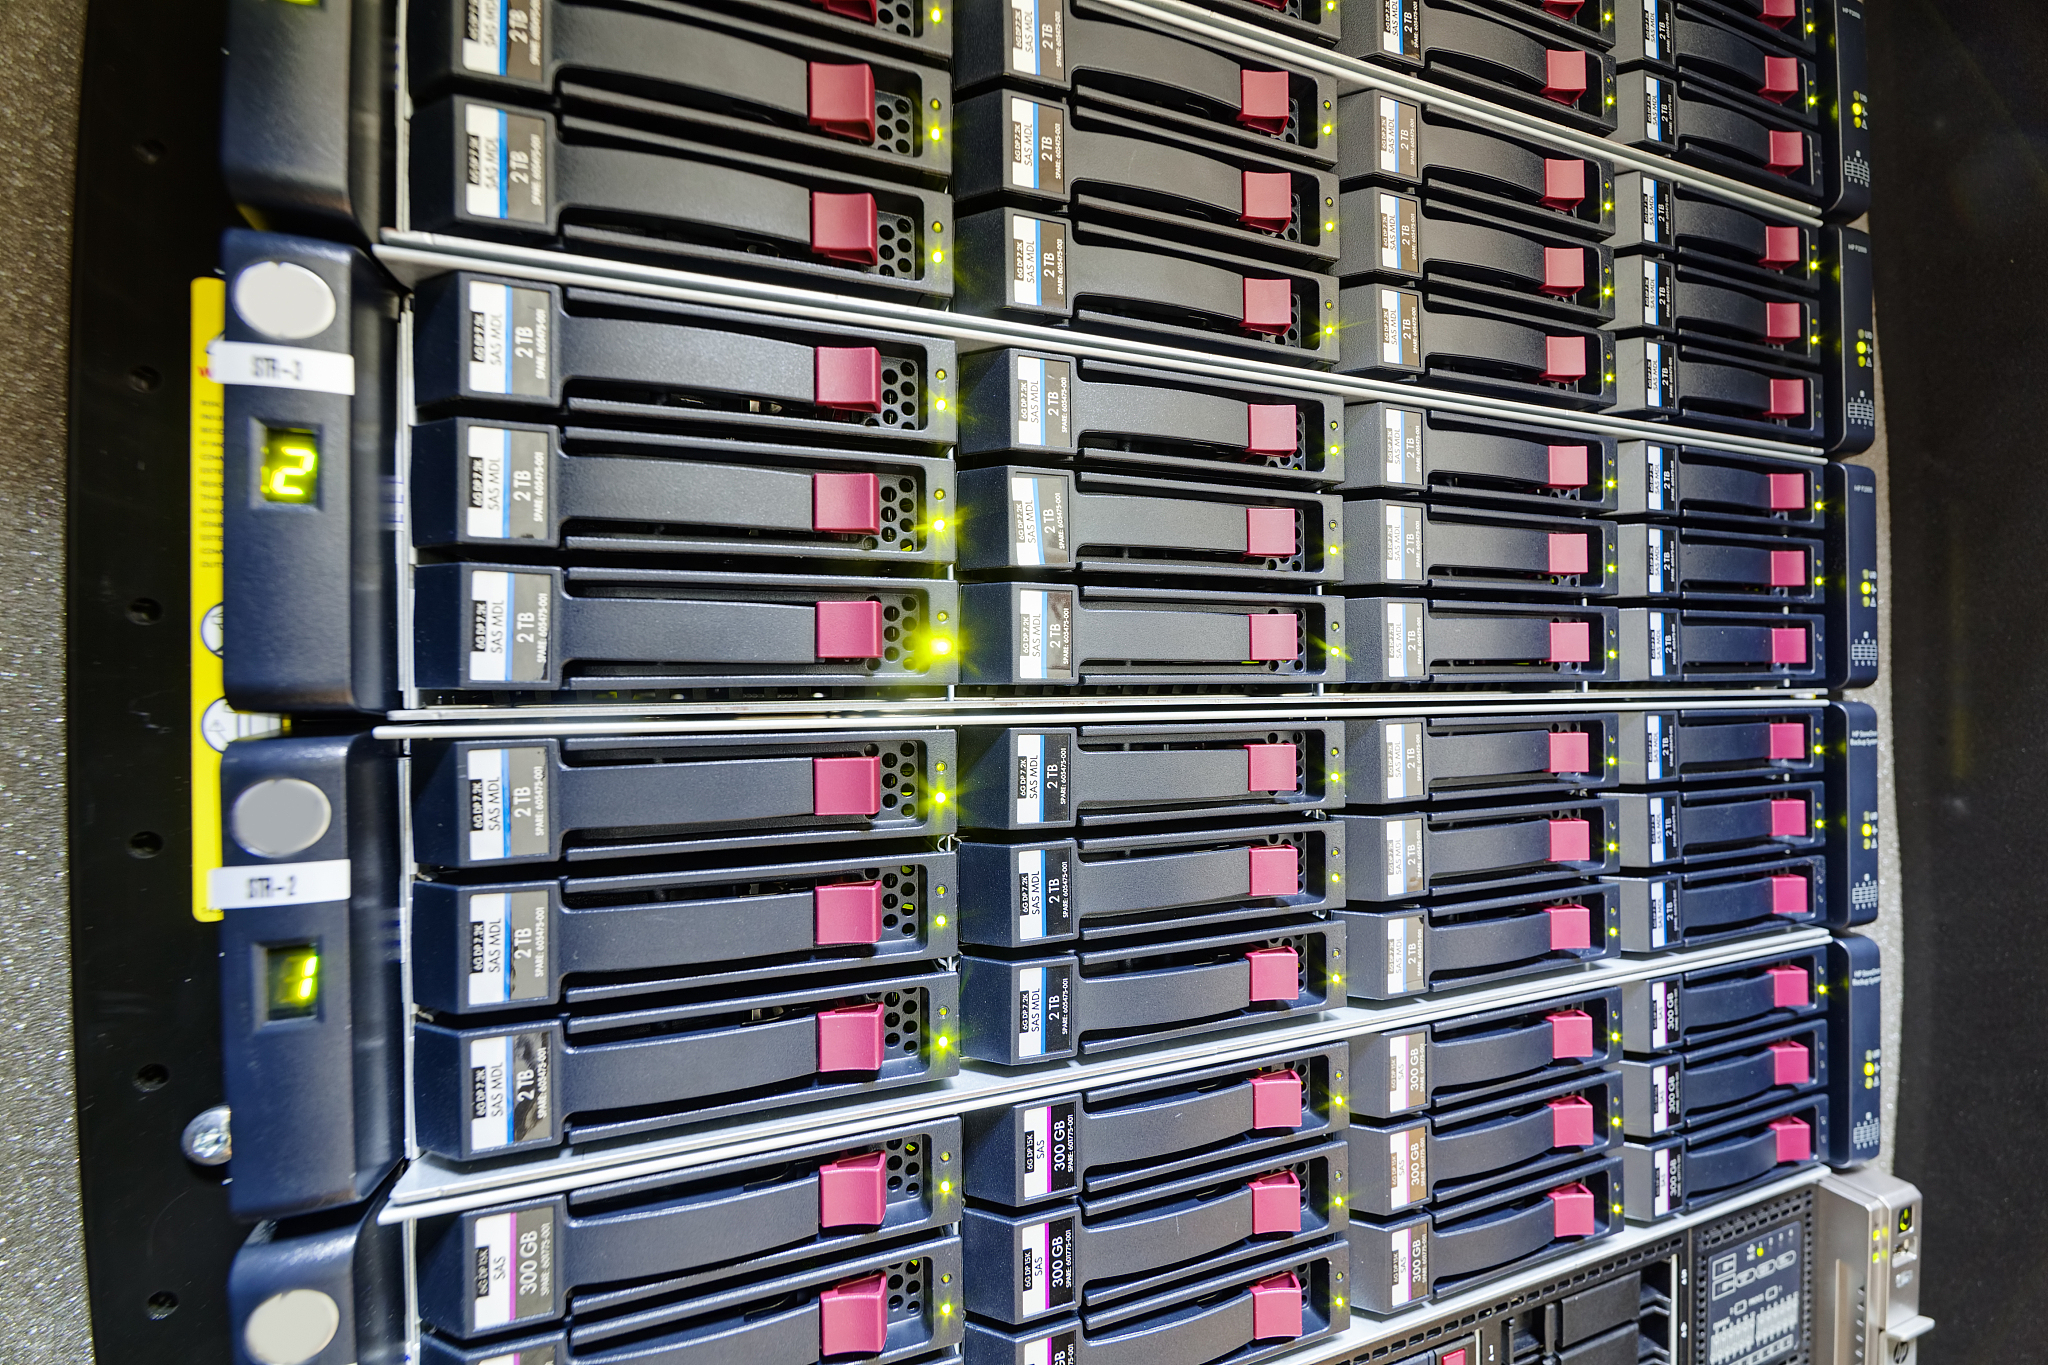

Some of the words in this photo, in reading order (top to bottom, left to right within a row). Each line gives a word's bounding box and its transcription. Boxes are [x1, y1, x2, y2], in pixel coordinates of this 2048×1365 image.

[1024, 9, 1033, 33] MDL
[1404, 11, 1412, 25] TB
[1041, 23, 1053, 40] TB
[1404, 25, 1412, 34] 2
[1025, 34, 1033, 54] SAS
[1042, 40, 1053, 50] 2
[1023, 122, 1032, 146] MDL
[1400, 128, 1408, 142] TB
[1041, 136, 1052, 152] TB
[1400, 142, 1409, 151] 2
[511, 151, 528, 171] TB
[1024, 147, 1032, 167] SAS
[1041, 152, 1053, 162] 2
[511, 172, 528, 184] 2
[1401, 224, 1410, 238] TB
[1026, 239, 1035, 263] MDL
[1402, 238, 1410, 246] 2
[1043, 252, 1055, 268] TB
[1026, 264, 1035, 284] SAS
[1044, 269, 1055, 278] 2
[1402, 318, 1411, 331] TB
[516, 326, 533, 346] TB
[1403, 332, 1411, 340] 2
[490, 342, 502, 367] SAS
[517, 347, 533, 359] 2
[1030, 379, 1039, 402] MDL
[1047, 391, 1059, 406] TB
[1030, 404, 1039, 424] SAS
[1048, 408, 1059, 417] 2
[1406, 437, 1414, 450] TB
[1406, 451, 1414, 459] 2
[269, 446, 317, 495] 2
[489, 456, 501, 485] MDL
[514, 470, 531, 489] TB
[488, 487, 500, 511] SAS
[514, 491, 531, 502] 2
[1024, 499, 1035, 522] MDL
[1042, 509, 1055, 523] TB
[1026, 525, 1036, 543] SAS
[1406, 533, 1414, 546] TB
[492, 599, 505, 627] MDL
[517, 612, 534, 630] TB
[1032, 613, 1041, 636] MDL
[1049, 623, 1061, 638] TB
[491, 630, 503, 654] SAS
[517, 633, 534, 643] 2
[1050, 640, 1061, 648] 2
[1407, 630, 1416, 642] TB
[1032, 638, 1040, 657] SAS
[1406, 748, 1415, 760] TB
[1030, 755, 1038, 777] MDL
[1047, 764, 1058, 778] TB
[1020, 775, 1026, 784] DP
[1047, 781, 1058, 789] 2
[487, 776, 500, 804] MDL
[514, 787, 531, 805] TB
[1020, 785, 1026, 796] 6G
[1029, 780, 1038, 799] SAS
[488, 808, 501, 831] SAS
[514, 808, 531, 818] 2
[1407, 844, 1415, 857] TB
[1031, 871, 1040, 893] MDL
[1048, 878, 1060, 893] TB
[1061, 861, 1069, 897] 605475-001
[1022, 892, 1028, 901] DP
[1031, 896, 1040, 915] SAS
[1049, 895, 1060, 904] 2
[1022, 902, 1028, 913] 6G
[489, 918, 501, 946] MDL
[515, 928, 531, 946] TB
[515, 949, 531, 959] 2
[1408, 943, 1416, 956] TB
[488, 950, 501, 973] SAS
[298, 956, 319, 999] 1
[1031, 988, 1040, 1011] MDL
[1049, 995, 1060, 1010] TB
[1031, 1013, 1040, 1032] SAS
[1049, 1012, 1060, 1020] 2
[1410, 1048, 1419, 1066] GB
[491, 1062, 504, 1091] MDL
[517, 1069, 534, 1089] TB
[1410, 1067, 1419, 1091] 300
[518, 1090, 534, 1102] 2
[491, 1093, 504, 1118] SAS
[1054, 1120, 1065, 1141] GB
[1027, 1147, 1033, 1157] DP
[1036, 1139, 1044, 1159] SAS
[1054, 1144, 1065, 1171] 300
[1410, 1142, 1419, 1161] GB
[1027, 1158, 1033, 1169] 6G
[1411, 1162, 1420, 1186] 300
[520, 1231, 538, 1257] GB
[1052, 1236, 1063, 1258] GB
[1412, 1239, 1421, 1257] GB
[493, 1256, 506, 1281] SAS
[1034, 1256, 1042, 1277] SAS
[1052, 1260, 1064, 1288] 300
[1412, 1259, 1421, 1283] 300
[520, 1260, 538, 1295] 300
